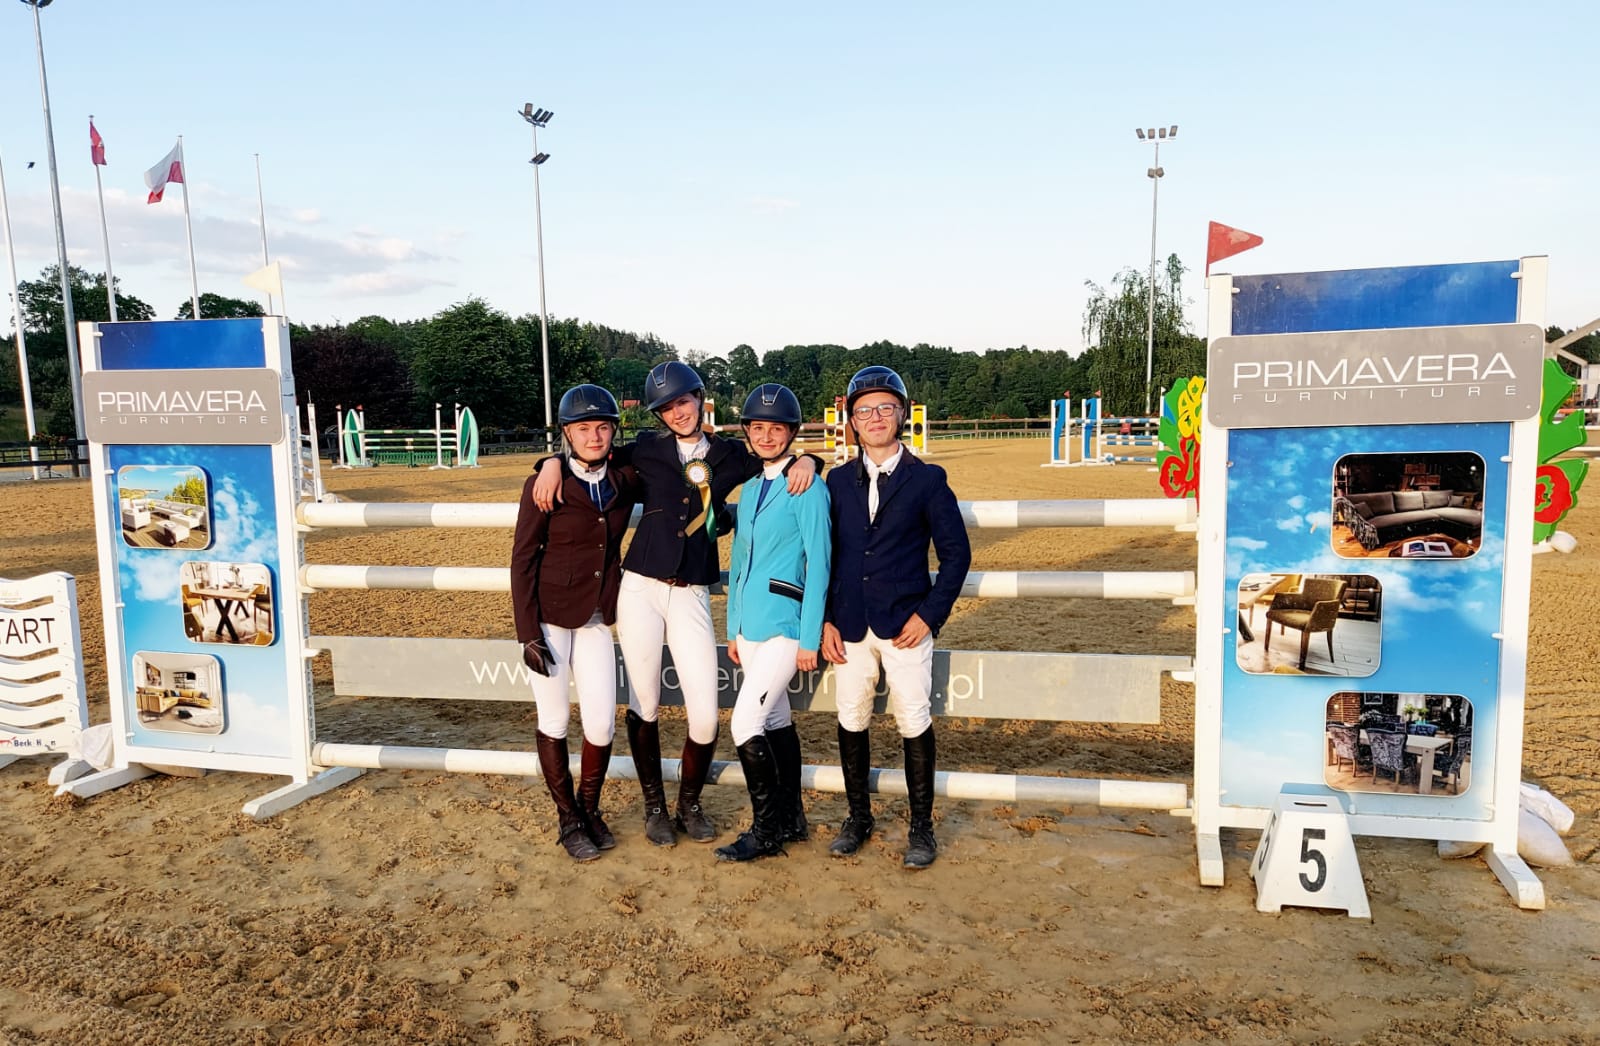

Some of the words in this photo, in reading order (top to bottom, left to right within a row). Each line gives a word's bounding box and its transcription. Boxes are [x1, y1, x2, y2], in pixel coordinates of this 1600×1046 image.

[1232, 352, 1518, 389] PRIMAVERA
[98, 390, 267, 413] PRIMAVERA
[1232, 385, 1518, 404] FURNITURE
[100, 415, 269, 425] FURNITURE
[1298, 827, 1327, 893] 5
